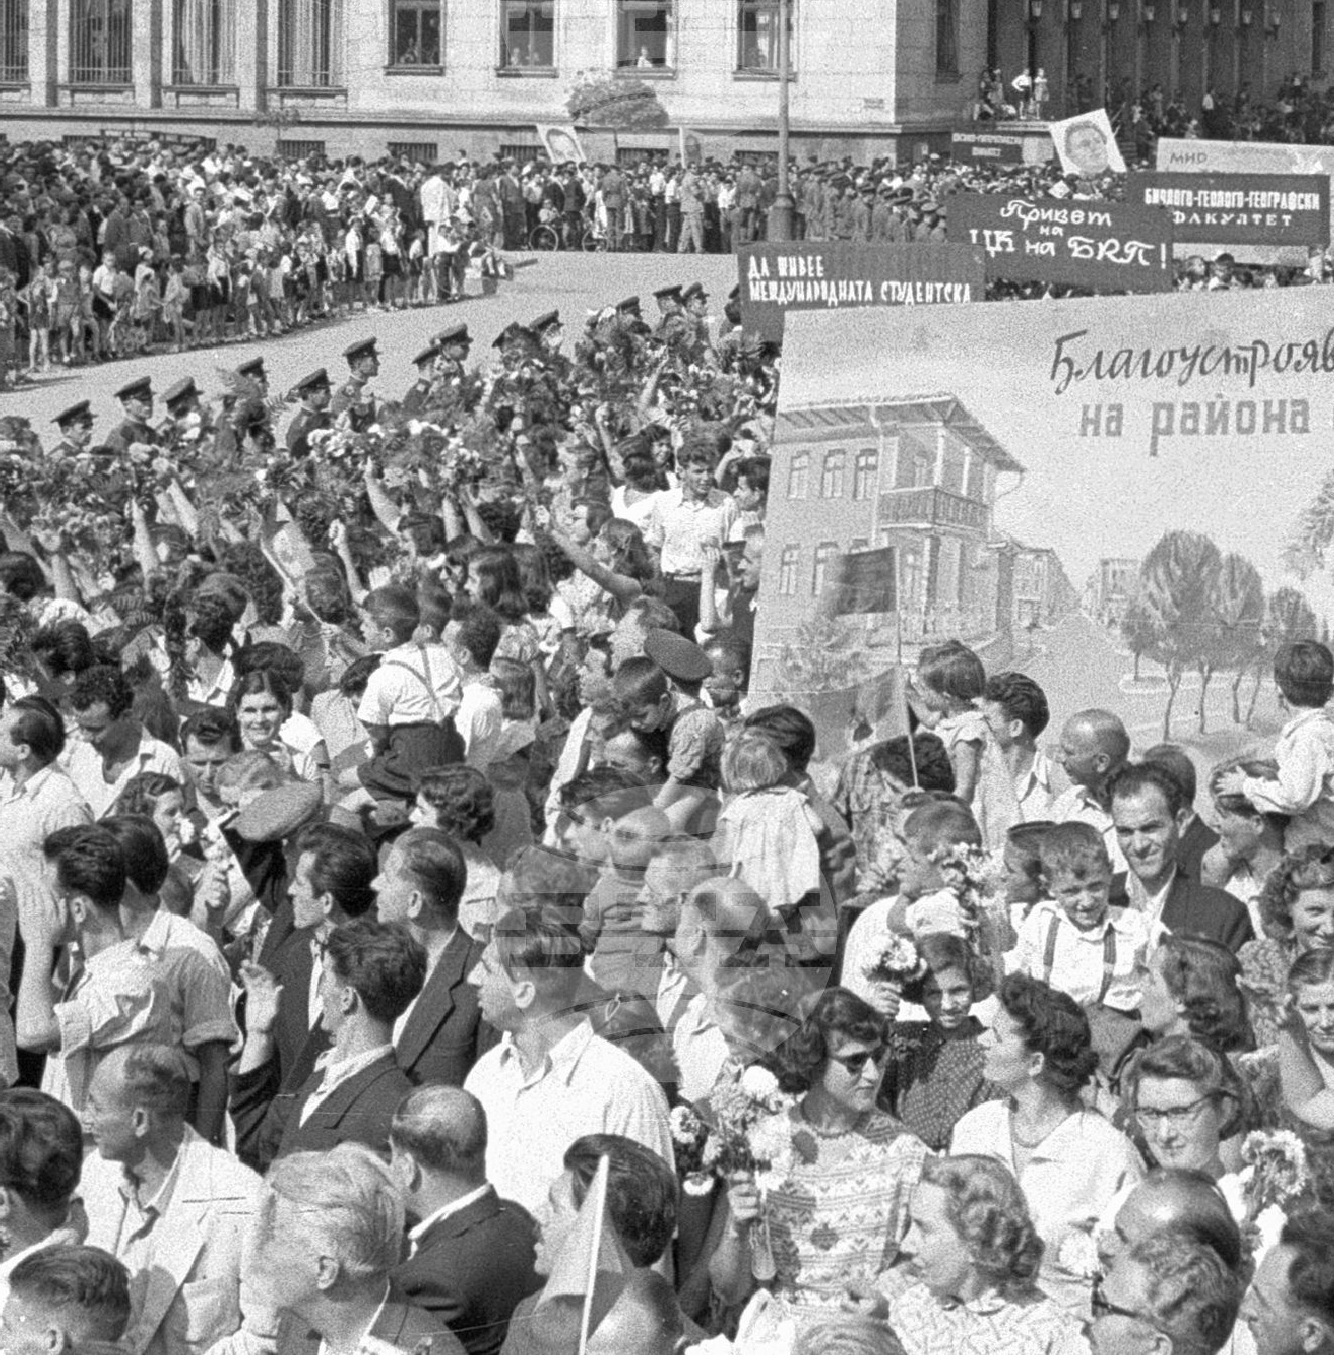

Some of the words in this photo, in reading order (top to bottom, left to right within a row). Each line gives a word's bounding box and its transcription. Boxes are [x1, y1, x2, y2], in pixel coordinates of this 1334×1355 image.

[1000, 199, 1112, 231] Привет
[1172, 210, 1292, 227] ФАКУЛТЕТ
[1039, 224, 1064, 237] на
[1025, 239, 1056, 257] на
[747, 255, 770, 279] ДА
[777, 255, 824, 278] ЖИВЕЕ
[749, 279, 873, 306] МЕЖДУНАРОДНАТА
[1079, 400, 1124, 437] на
[1149, 393, 1311, 457] района
